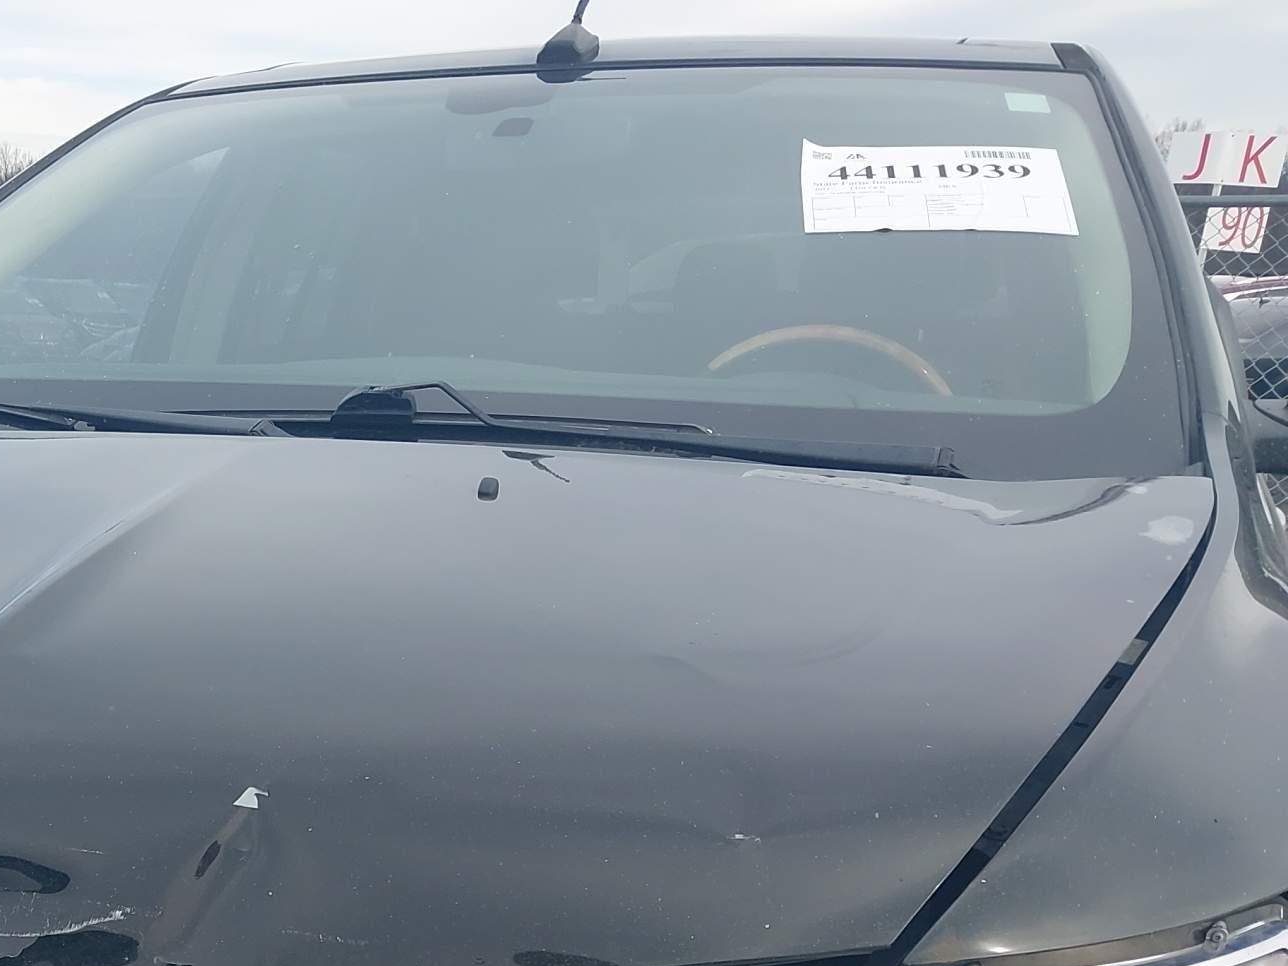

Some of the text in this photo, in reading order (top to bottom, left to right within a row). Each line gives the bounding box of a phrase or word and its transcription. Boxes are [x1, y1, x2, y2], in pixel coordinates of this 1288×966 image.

[827, 163, 1032, 180] 44111939
[1182, 133, 1278, 185] J K
[1218, 207, 1264, 249] 90
